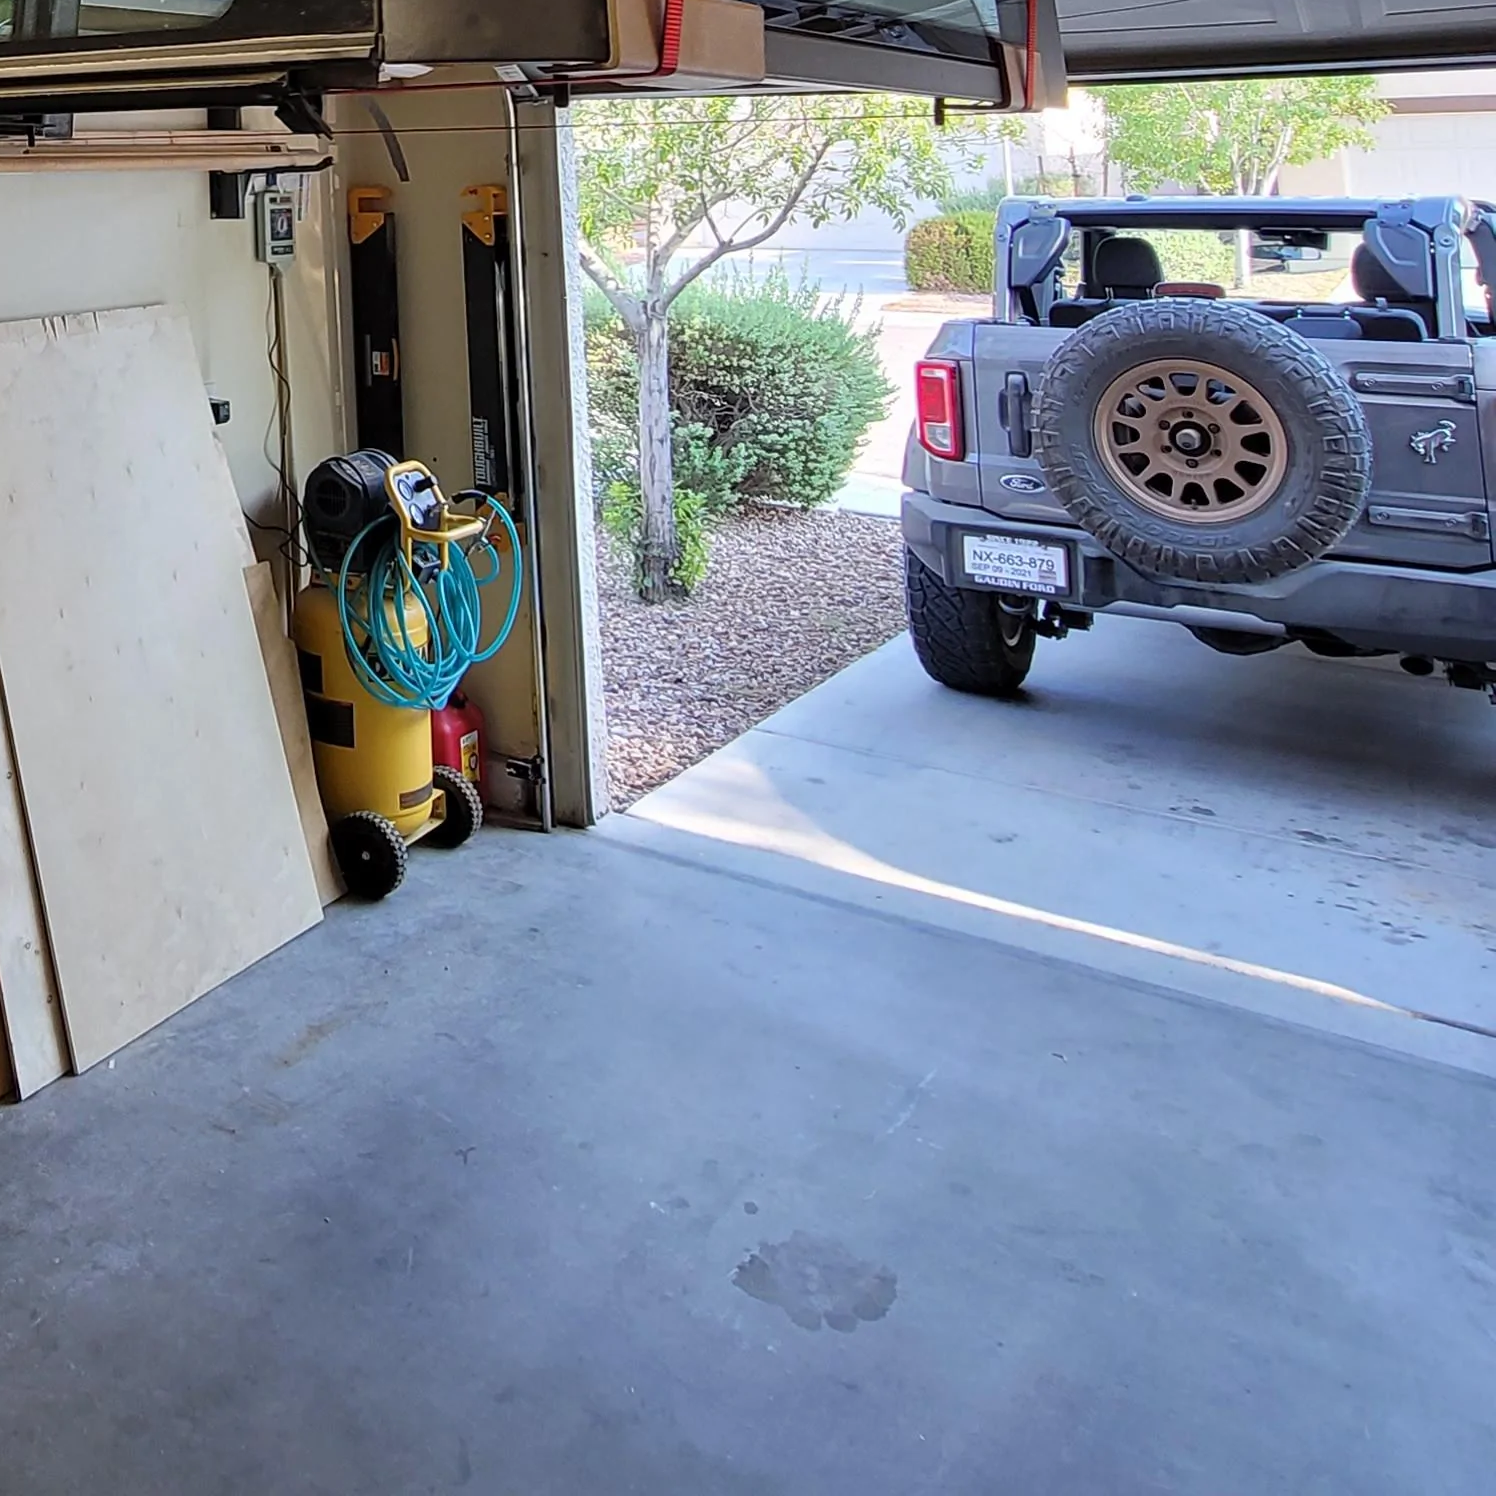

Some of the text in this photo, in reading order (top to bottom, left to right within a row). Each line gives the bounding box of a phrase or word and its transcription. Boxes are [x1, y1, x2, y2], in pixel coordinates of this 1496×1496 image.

[473, 417, 491, 486] TOUGHBUILT
[971, 562, 990, 571] SEP
[1011, 568, 1032, 577] 2021
[972, 550, 1055, 572] NX-663-879
[974, 575, 1056, 594] GAUDIN FORD
